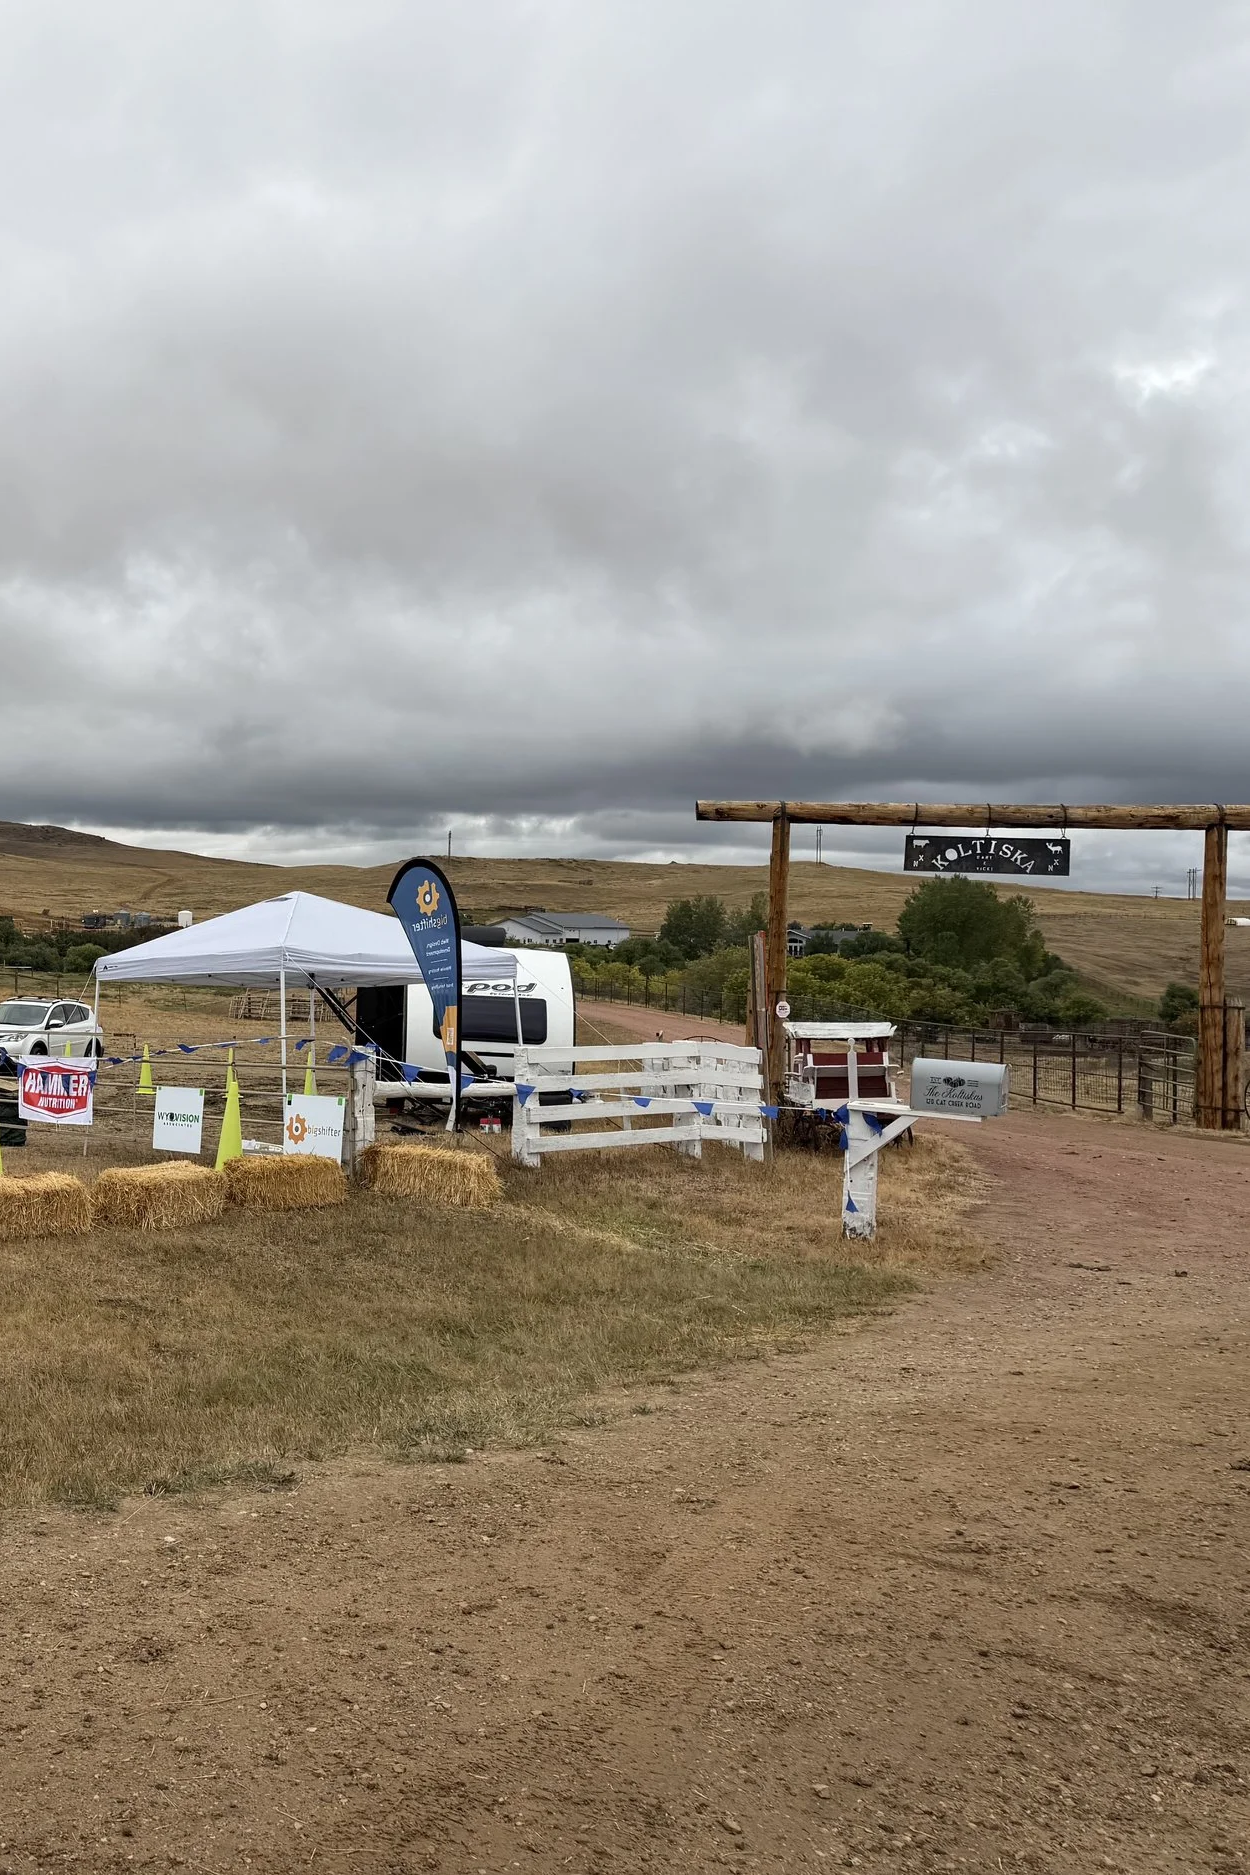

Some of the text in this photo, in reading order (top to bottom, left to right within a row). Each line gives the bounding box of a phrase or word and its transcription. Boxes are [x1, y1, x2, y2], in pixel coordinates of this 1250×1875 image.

[931, 840, 1035, 874] KOLTISKA
[923, 1084, 940, 1097] The
[37, 1096, 76, 1109] NUTRITION
[948, 1100, 963, 1108] CREEK
[307, 1125, 341, 1137] bigshifter
